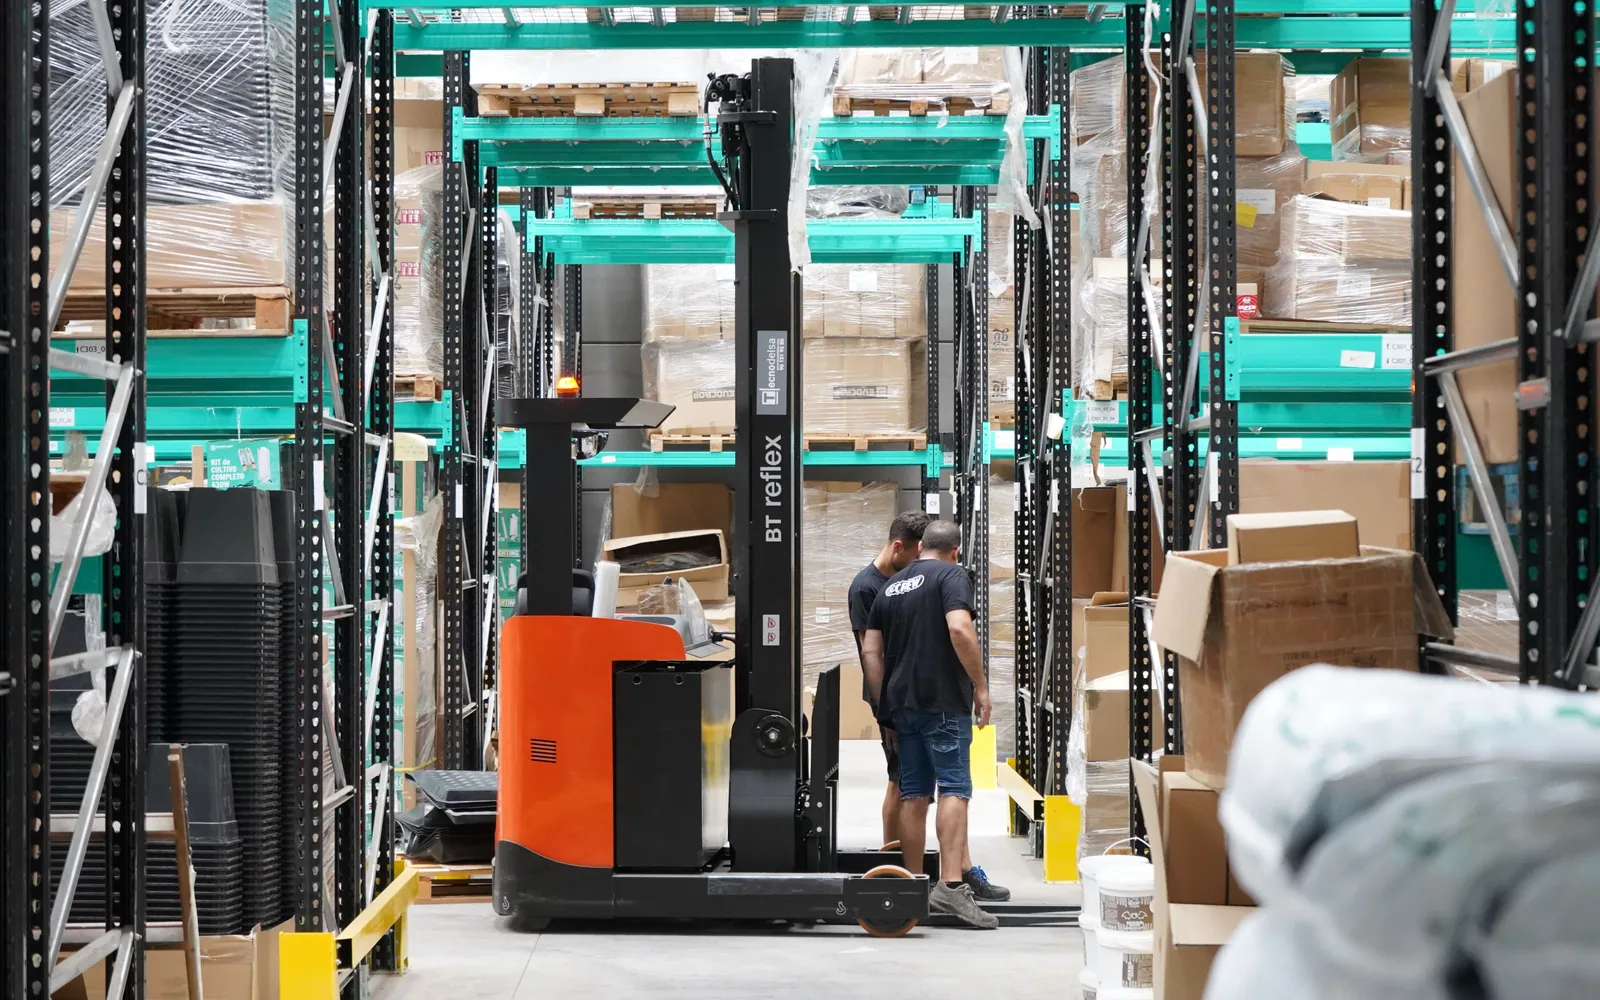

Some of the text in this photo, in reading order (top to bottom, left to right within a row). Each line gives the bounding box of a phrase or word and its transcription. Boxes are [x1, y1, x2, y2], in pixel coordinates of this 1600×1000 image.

[762, 338, 777, 405] Tecnodelsa
[222, 458, 231, 466] de
[211, 466, 237, 474] CULTIVO
[211, 473, 245, 481] COMPLETO
[760, 435, 782, 542] BT reflex
